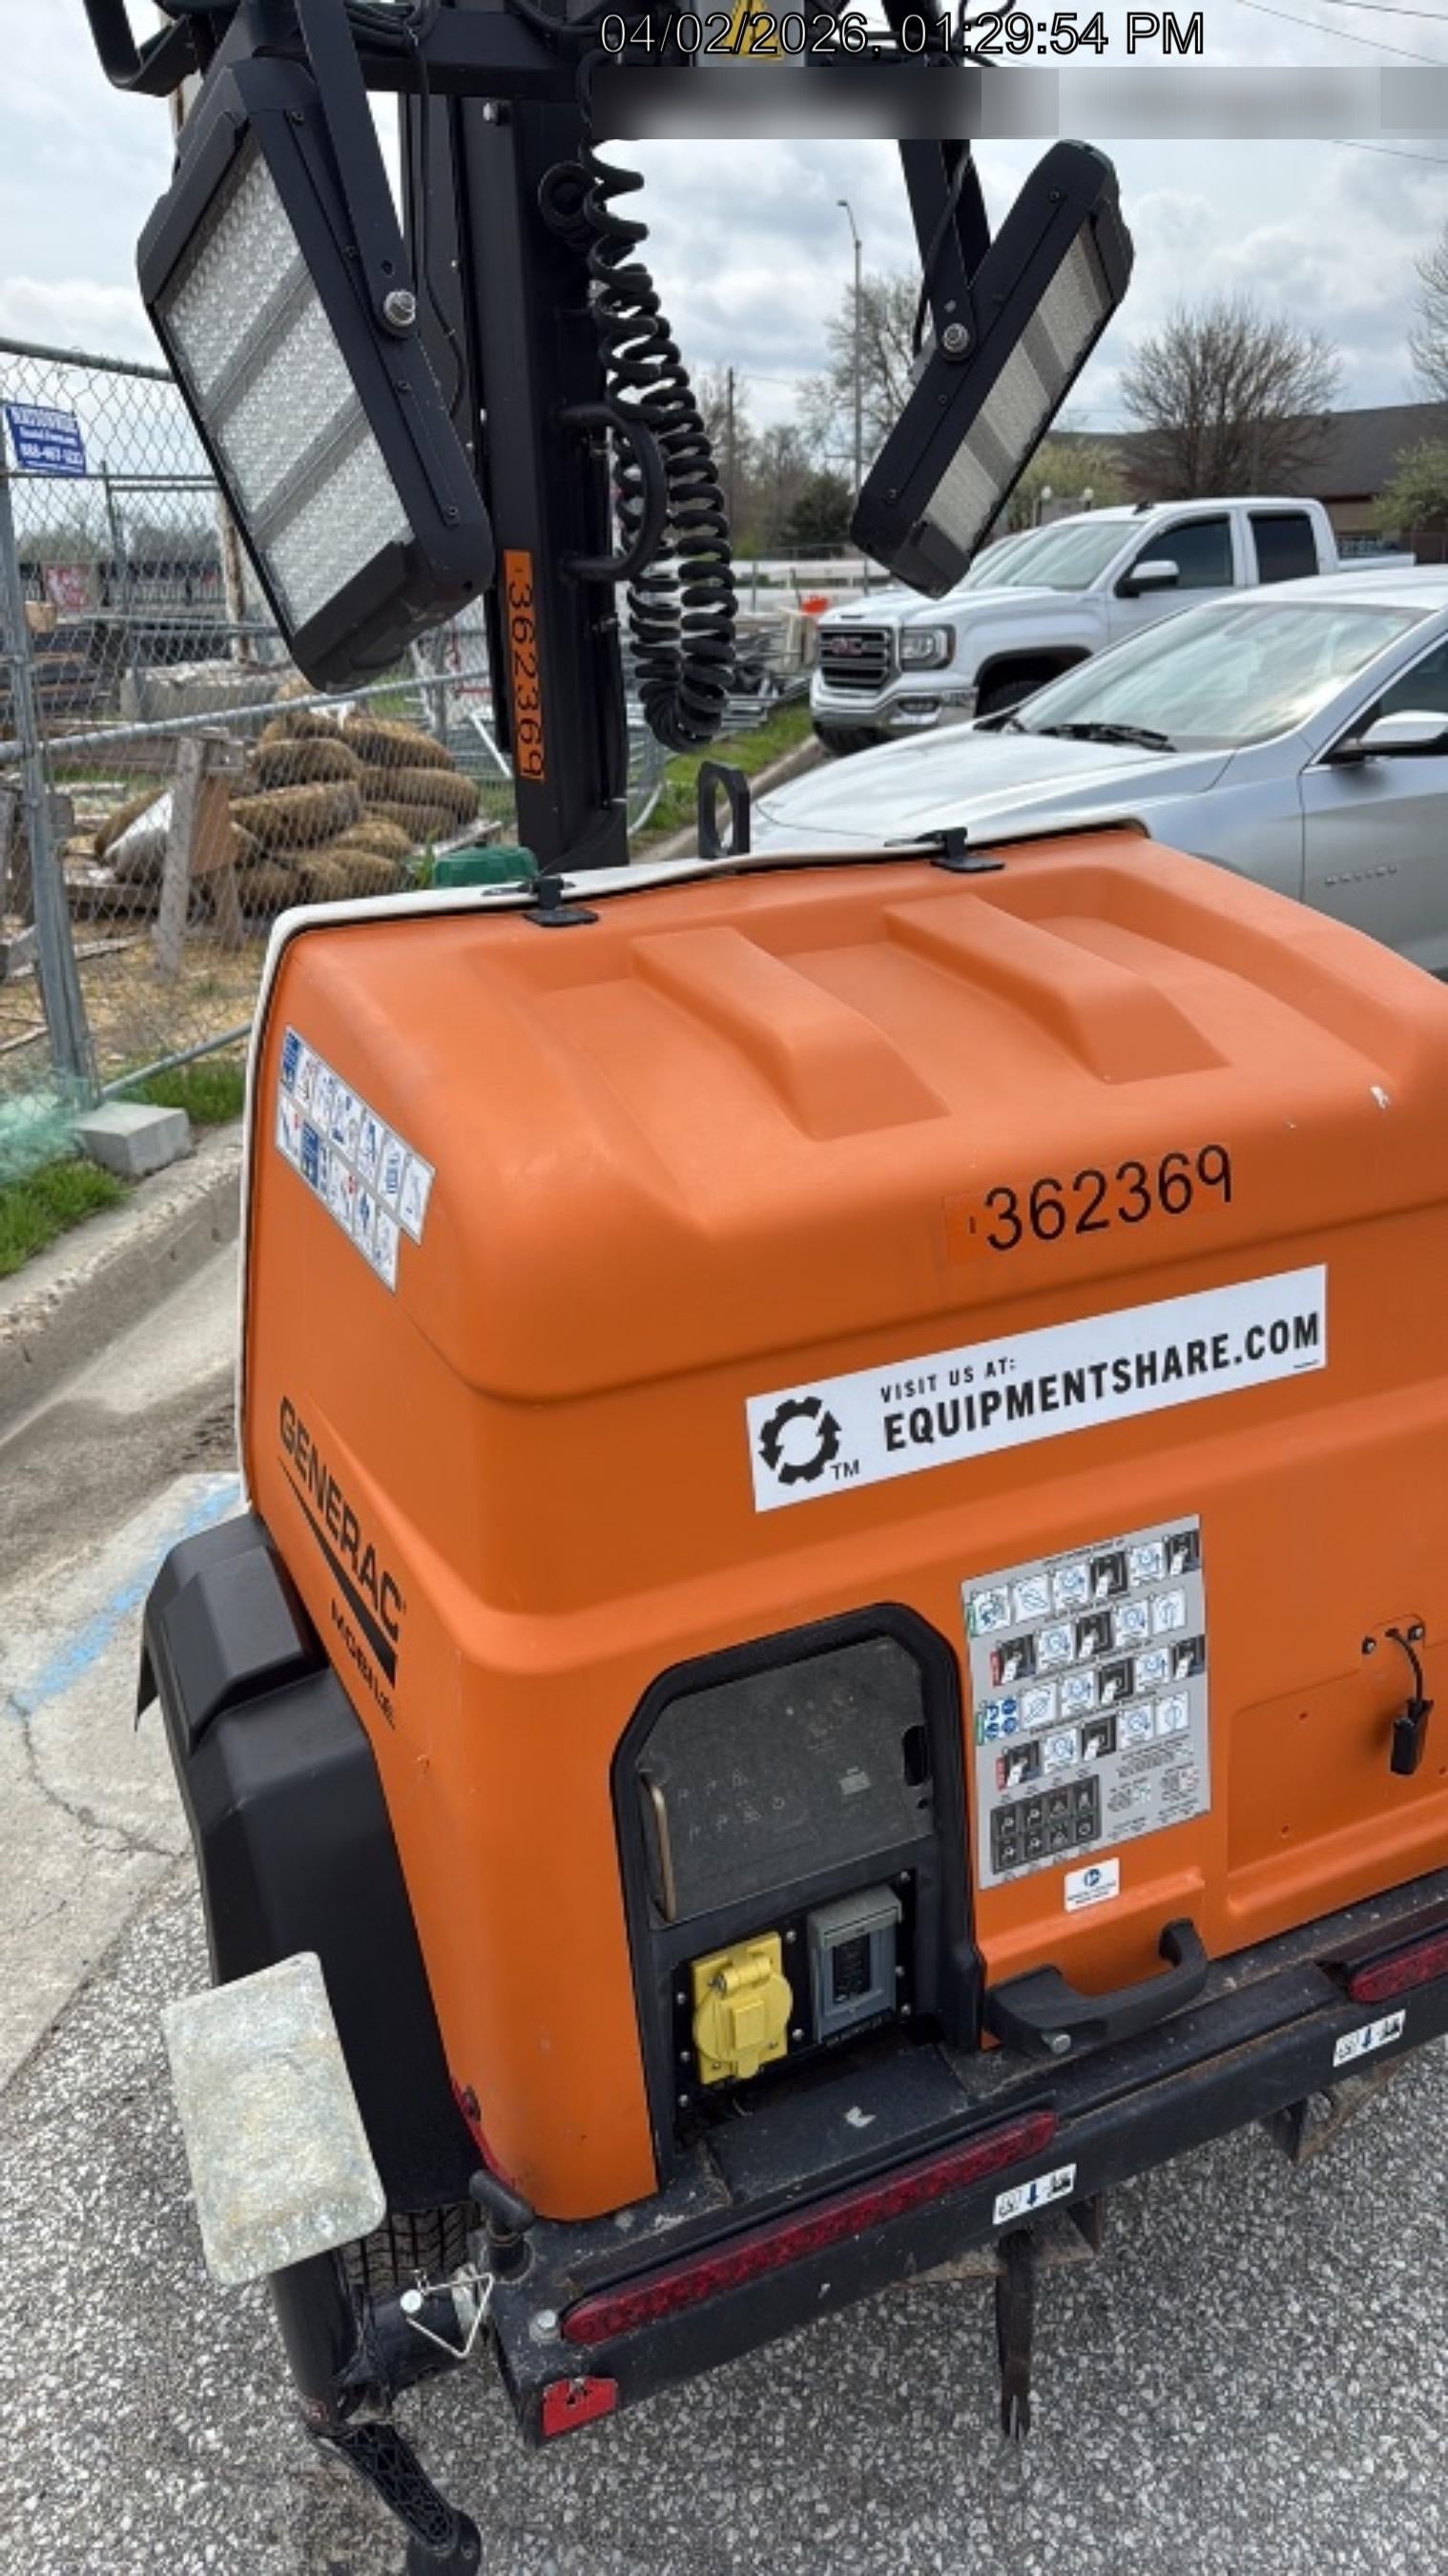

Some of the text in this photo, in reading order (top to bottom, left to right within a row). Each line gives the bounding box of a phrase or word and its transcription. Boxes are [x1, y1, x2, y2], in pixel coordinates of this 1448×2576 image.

[508, 580, 542, 776] 362369
[984, 1145, 1231, 1251] 362369
[879, 1356, 1017, 1404] VISIT US AT:
[882, 1312, 1319, 1451] EQUIPMENTSHARE.COM
[279, 1396, 402, 1643] GENERAC
[830, 1460, 860, 1482] TM
